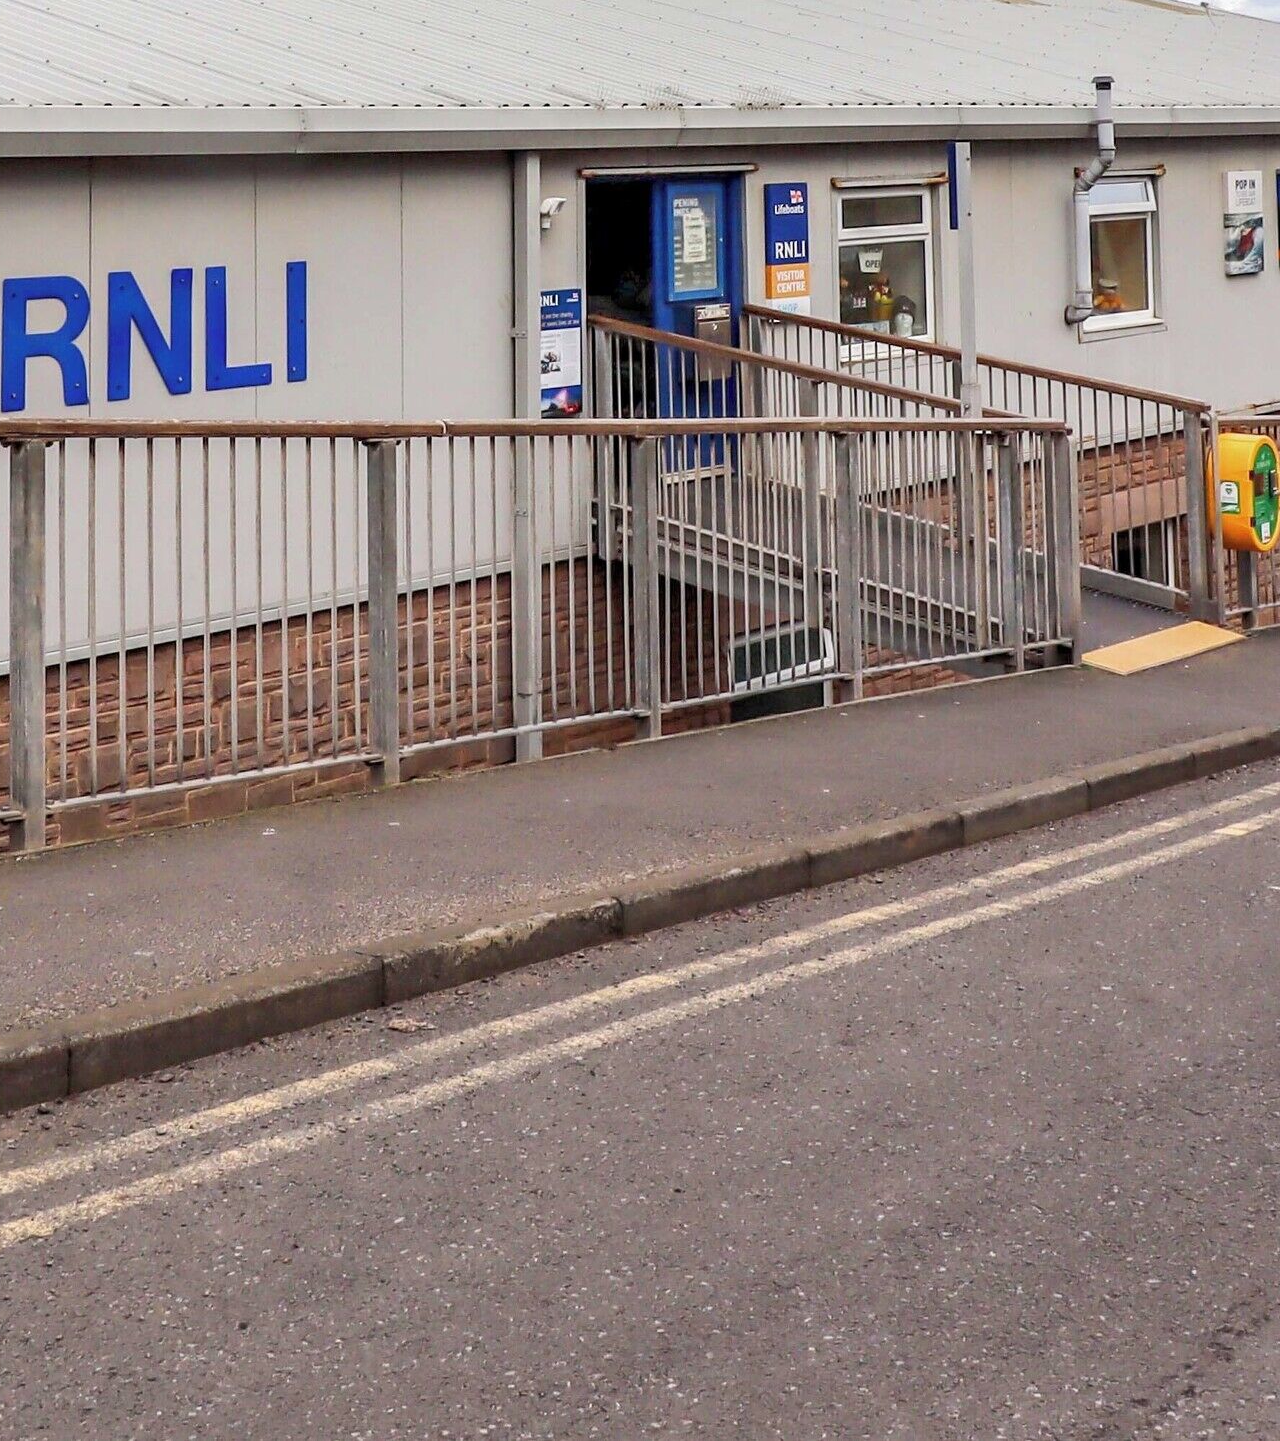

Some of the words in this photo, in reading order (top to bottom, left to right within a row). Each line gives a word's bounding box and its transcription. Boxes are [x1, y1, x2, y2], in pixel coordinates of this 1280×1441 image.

[1235, 179, 1247, 190] POP
[1248, 179, 1256, 189] IN
[775, 204, 804, 215] Lifeboats
[775, 240, 806, 259] RNLI
[776, 269, 805, 281] VISITOR
[777, 281, 806, 294] CENTRE
[1, 261, 308, 412] RNLI
